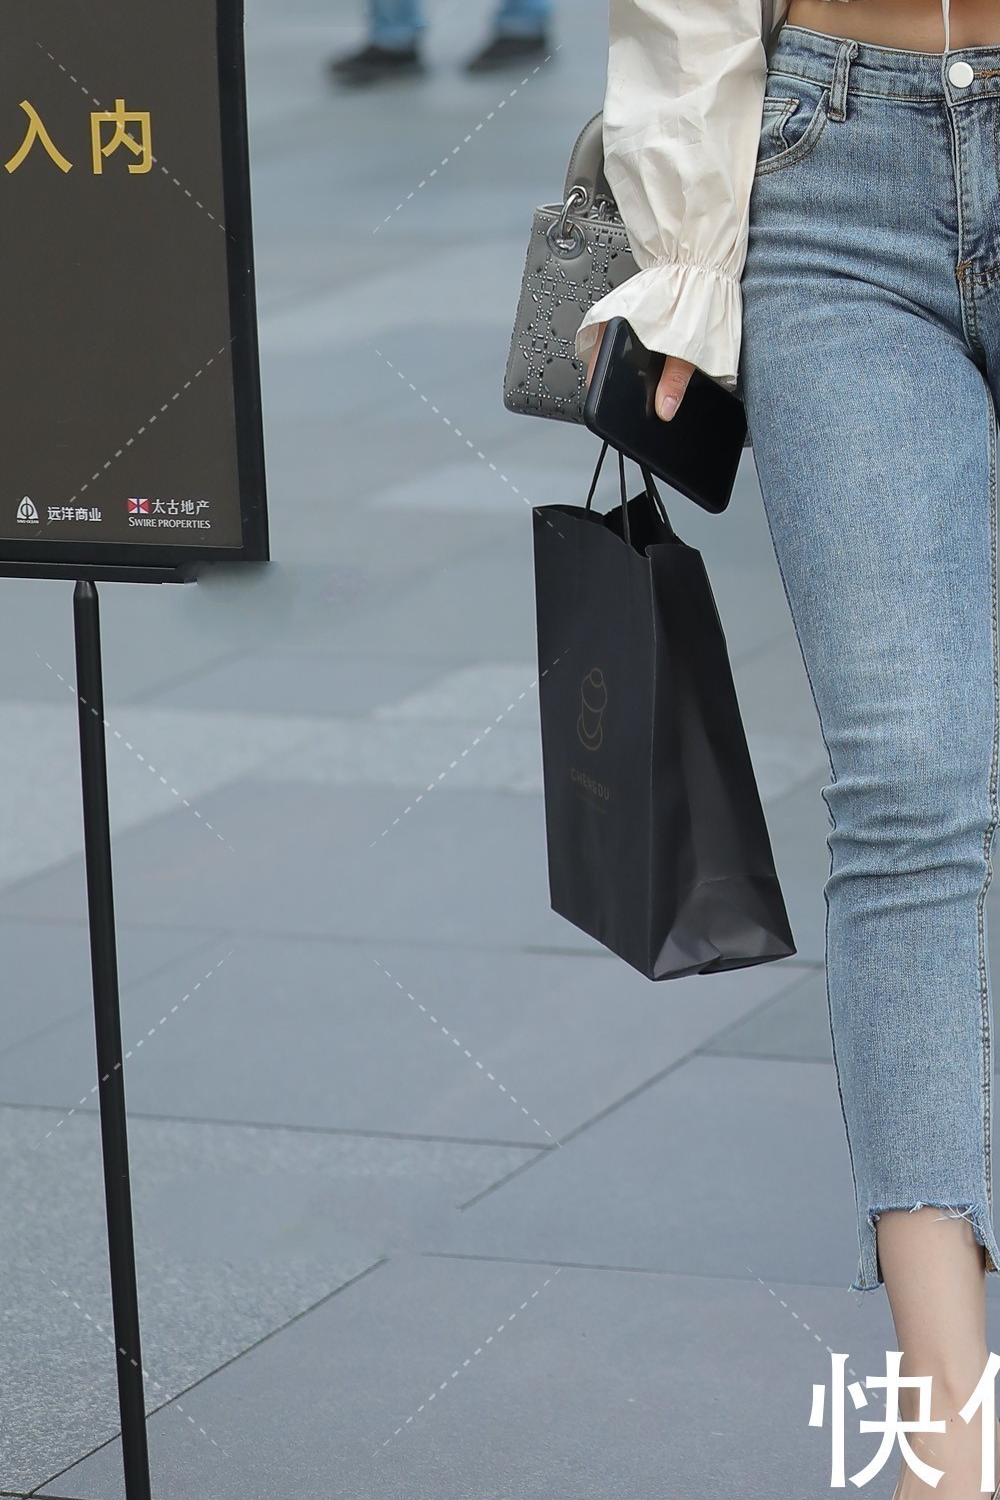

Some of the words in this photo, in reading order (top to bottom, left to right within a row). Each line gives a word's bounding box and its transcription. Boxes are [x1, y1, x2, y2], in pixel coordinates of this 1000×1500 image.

[4, 98, 153, 175] 入内
[47, 506, 102, 522] 远洋商业
[151, 498, 210, 515] 太古地产
[128, 516, 157, 528] SWIRE
[158, 517, 211, 529] PROPERTIES
[570, 767, 610, 801] CHENGDU
